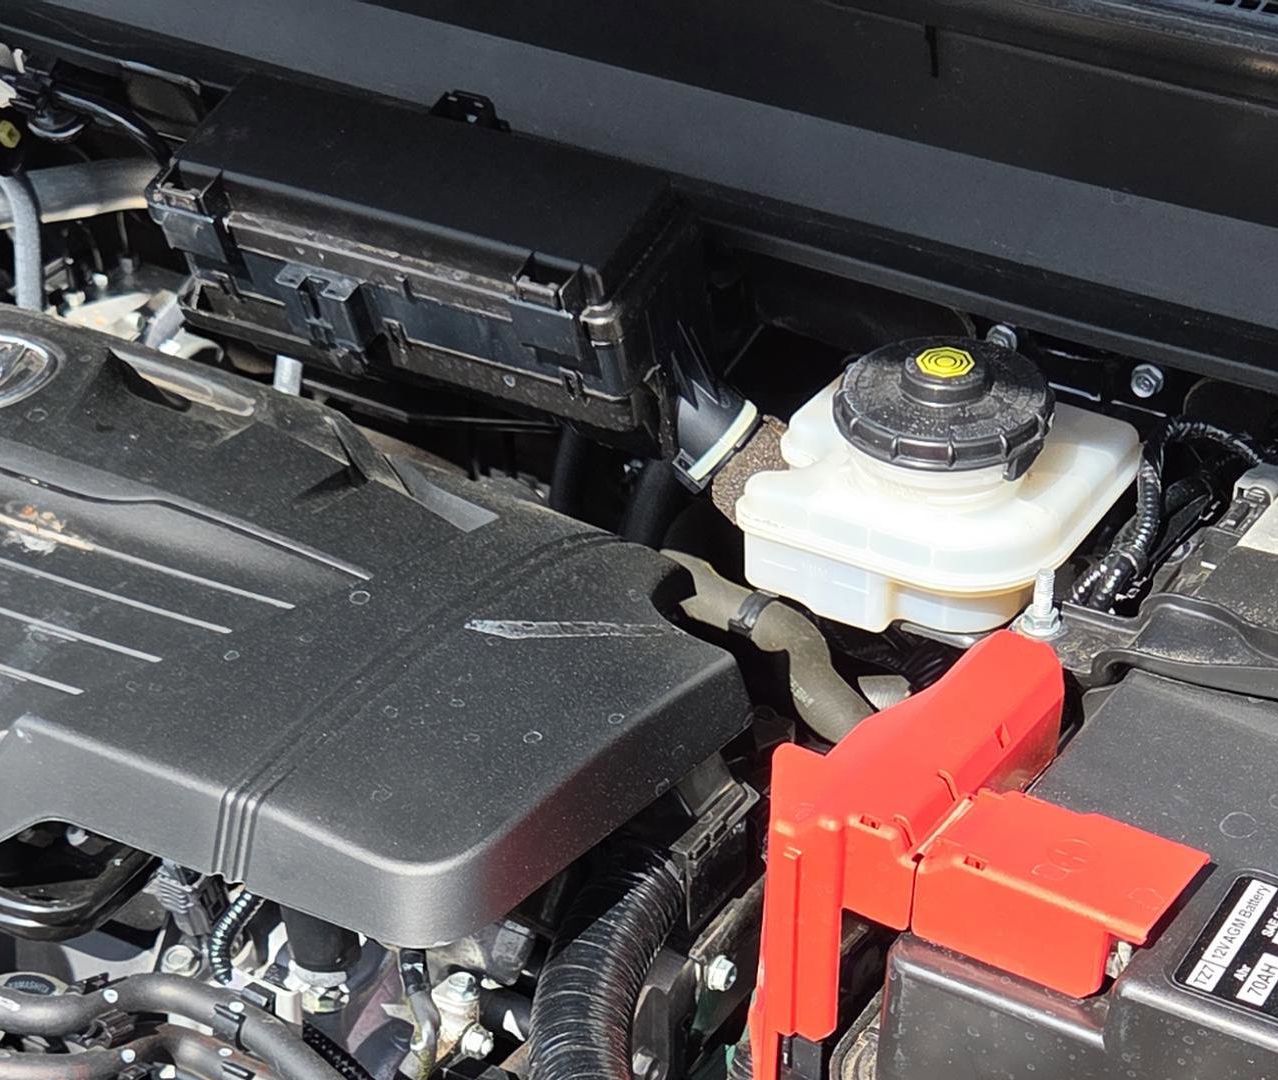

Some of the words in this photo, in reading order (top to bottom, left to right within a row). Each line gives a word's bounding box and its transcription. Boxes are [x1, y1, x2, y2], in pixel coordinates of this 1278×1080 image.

[1193, 964, 1216, 986] TZ7
[1212, 942, 1229, 959] 12V
[1222, 916, 1246, 943] AGM
[1239, 884, 1270, 918] Battery
[1248, 963, 1278, 997] 70AH
